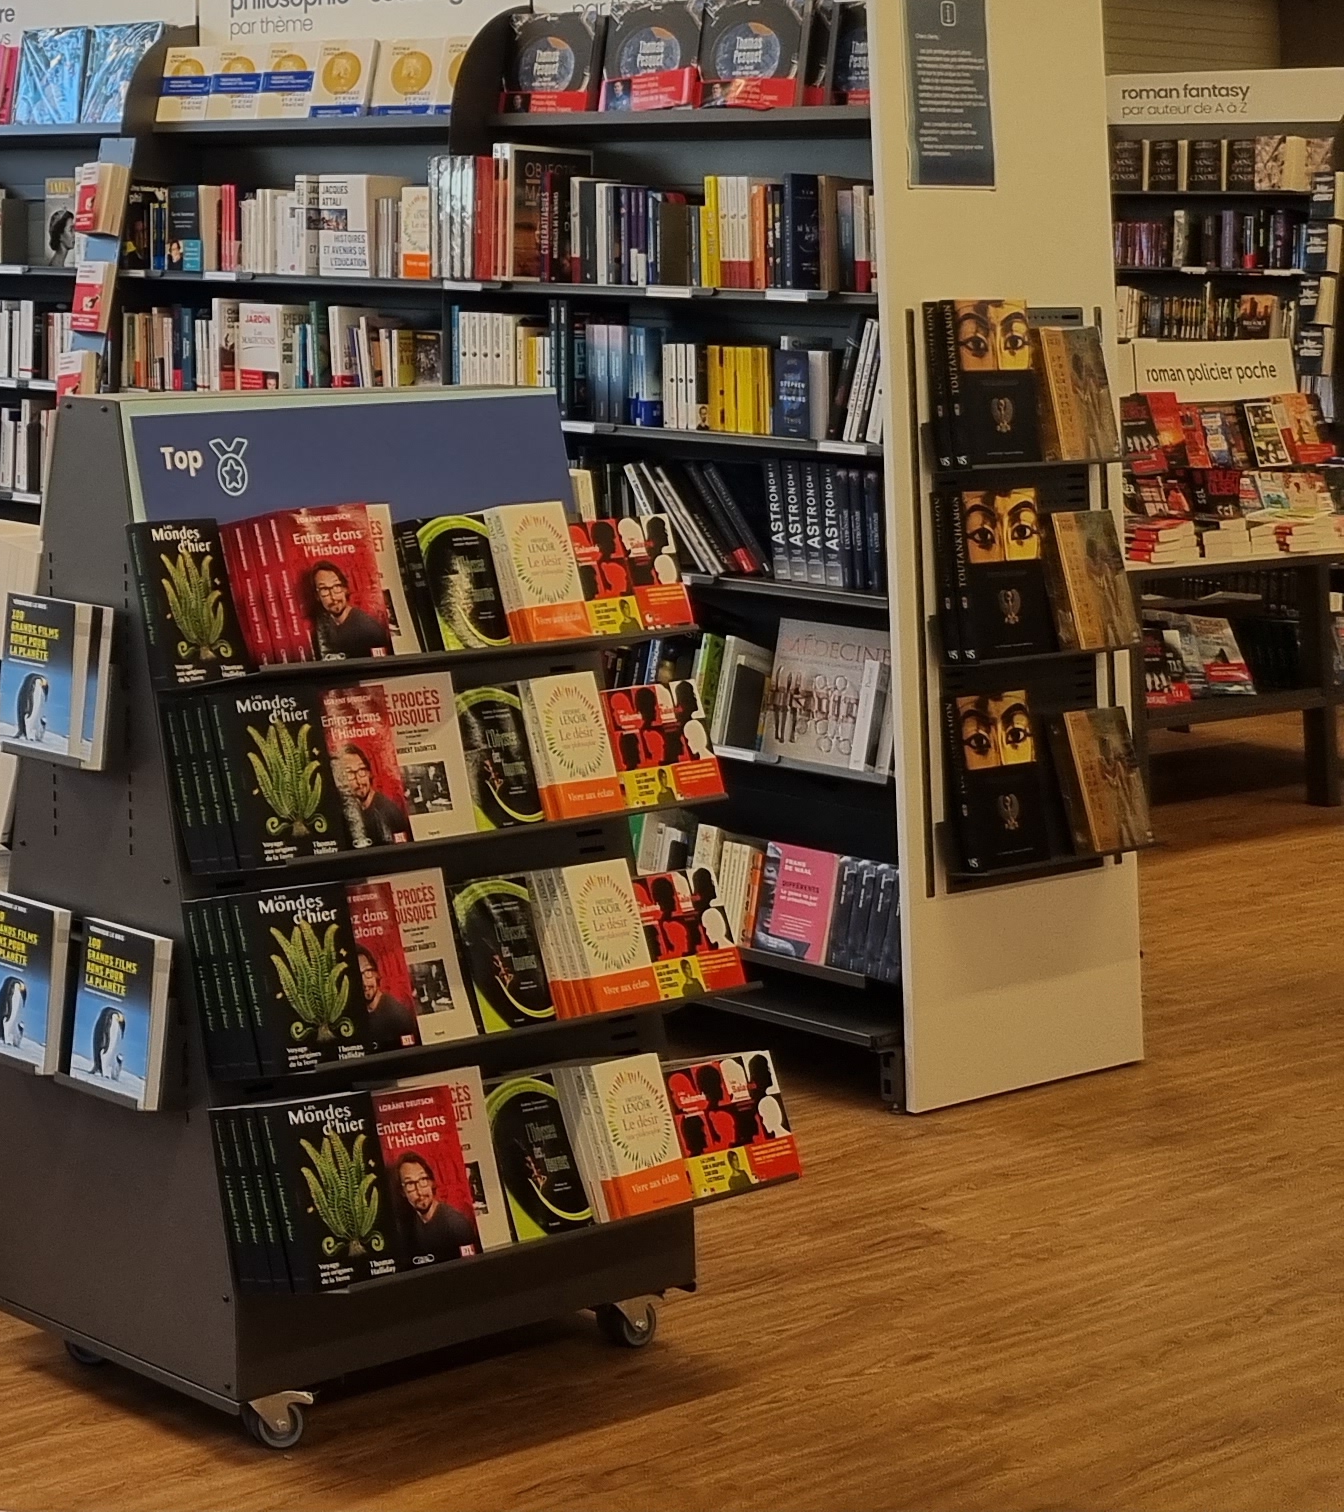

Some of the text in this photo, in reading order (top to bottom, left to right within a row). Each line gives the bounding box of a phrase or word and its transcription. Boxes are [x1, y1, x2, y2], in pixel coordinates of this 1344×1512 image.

[230, 15, 314, 40] par thème
[1121, 82, 1251, 104] roman fantasy
[1121, 100, 1248, 118] par auteur de A à Z
[1145, 360, 1278, 387] roman policier poche
[160, 445, 204, 477] Top
[151, 527, 201, 542] Mondes
[177, 538, 212, 552] d'hier
[392, 687, 440, 709] PROCÈS
[376, 1114, 446, 1136] Entrez dans
[386, 1130, 440, 1150] l'Histoire
